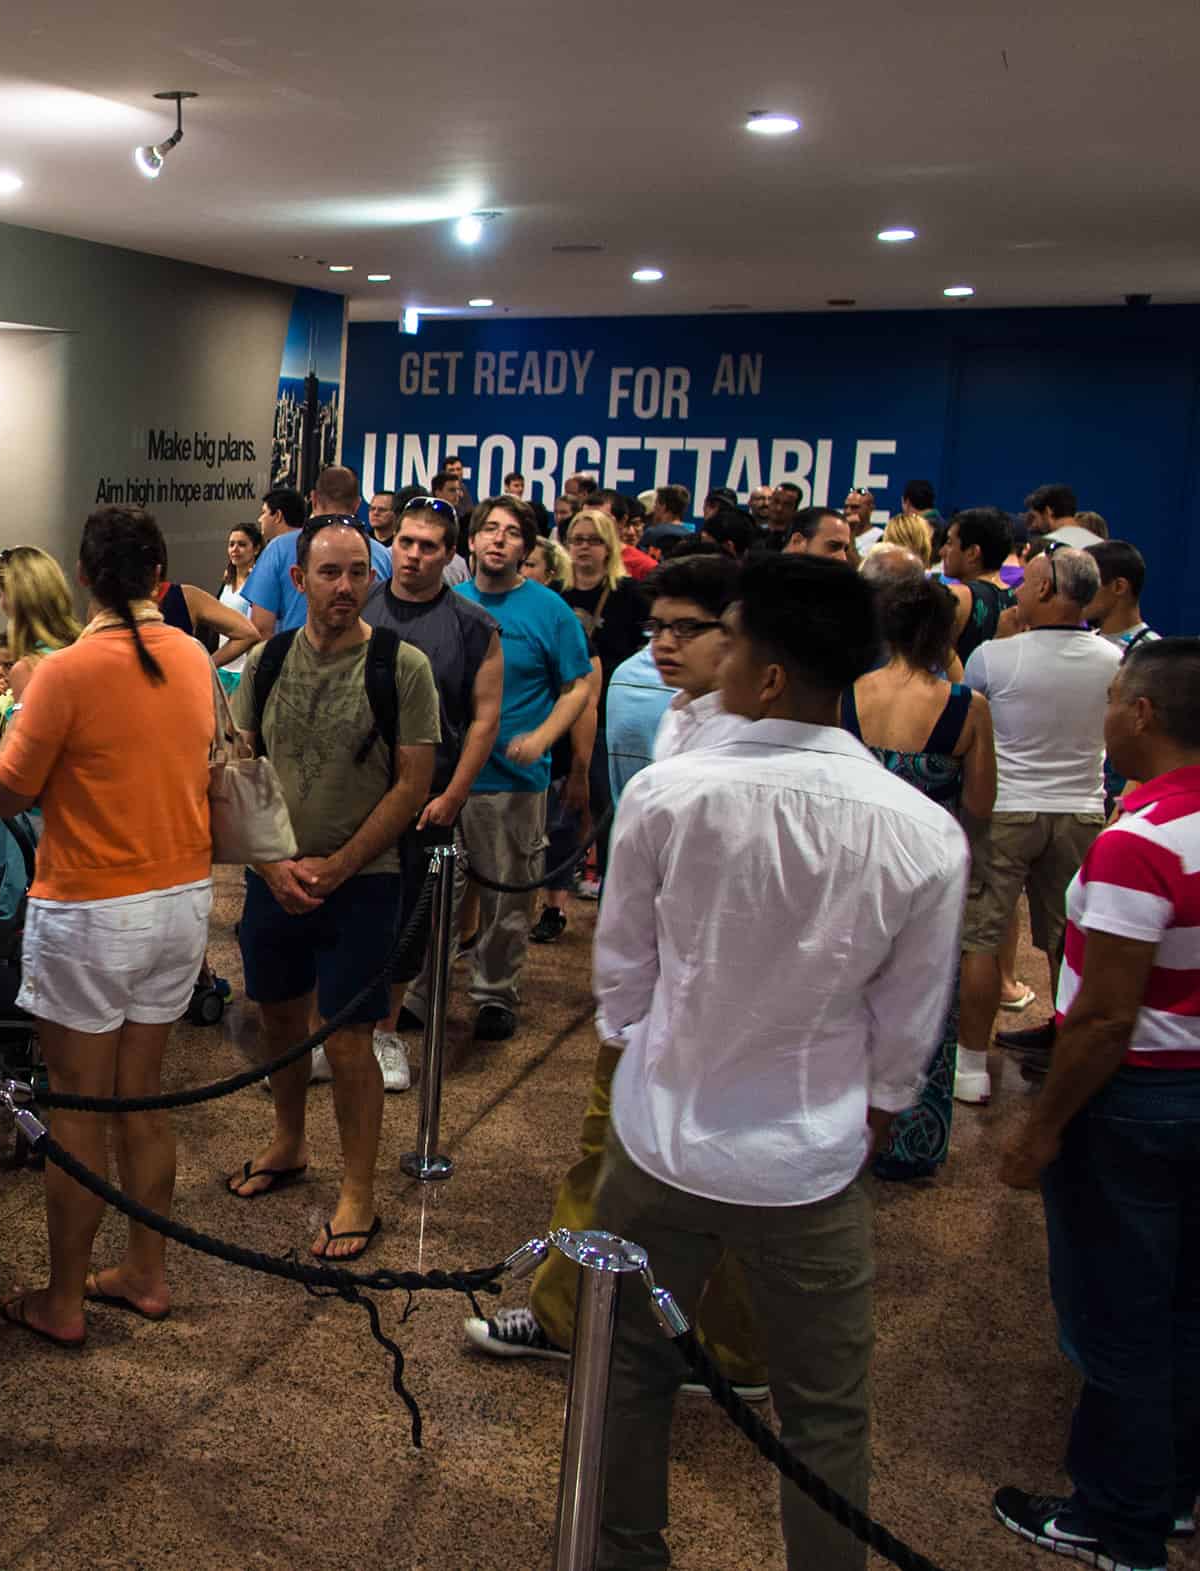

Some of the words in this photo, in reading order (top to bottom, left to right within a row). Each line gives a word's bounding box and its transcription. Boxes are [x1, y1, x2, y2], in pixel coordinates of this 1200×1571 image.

[400, 352, 463, 395] GET
[473, 350, 595, 395] READY
[608, 367, 692, 419] FOR
[712, 353, 762, 396] AN
[148, 429, 192, 462] Make
[194, 431, 216, 468] big
[218, 432, 257, 467] plans.
[96, 478, 123, 504] Aim
[126, 477, 155, 508] high
[158, 479, 169, 501] in
[171, 477, 200, 507] hope
[202, 477, 225, 501] and
[226, 477, 256, 499] work.
